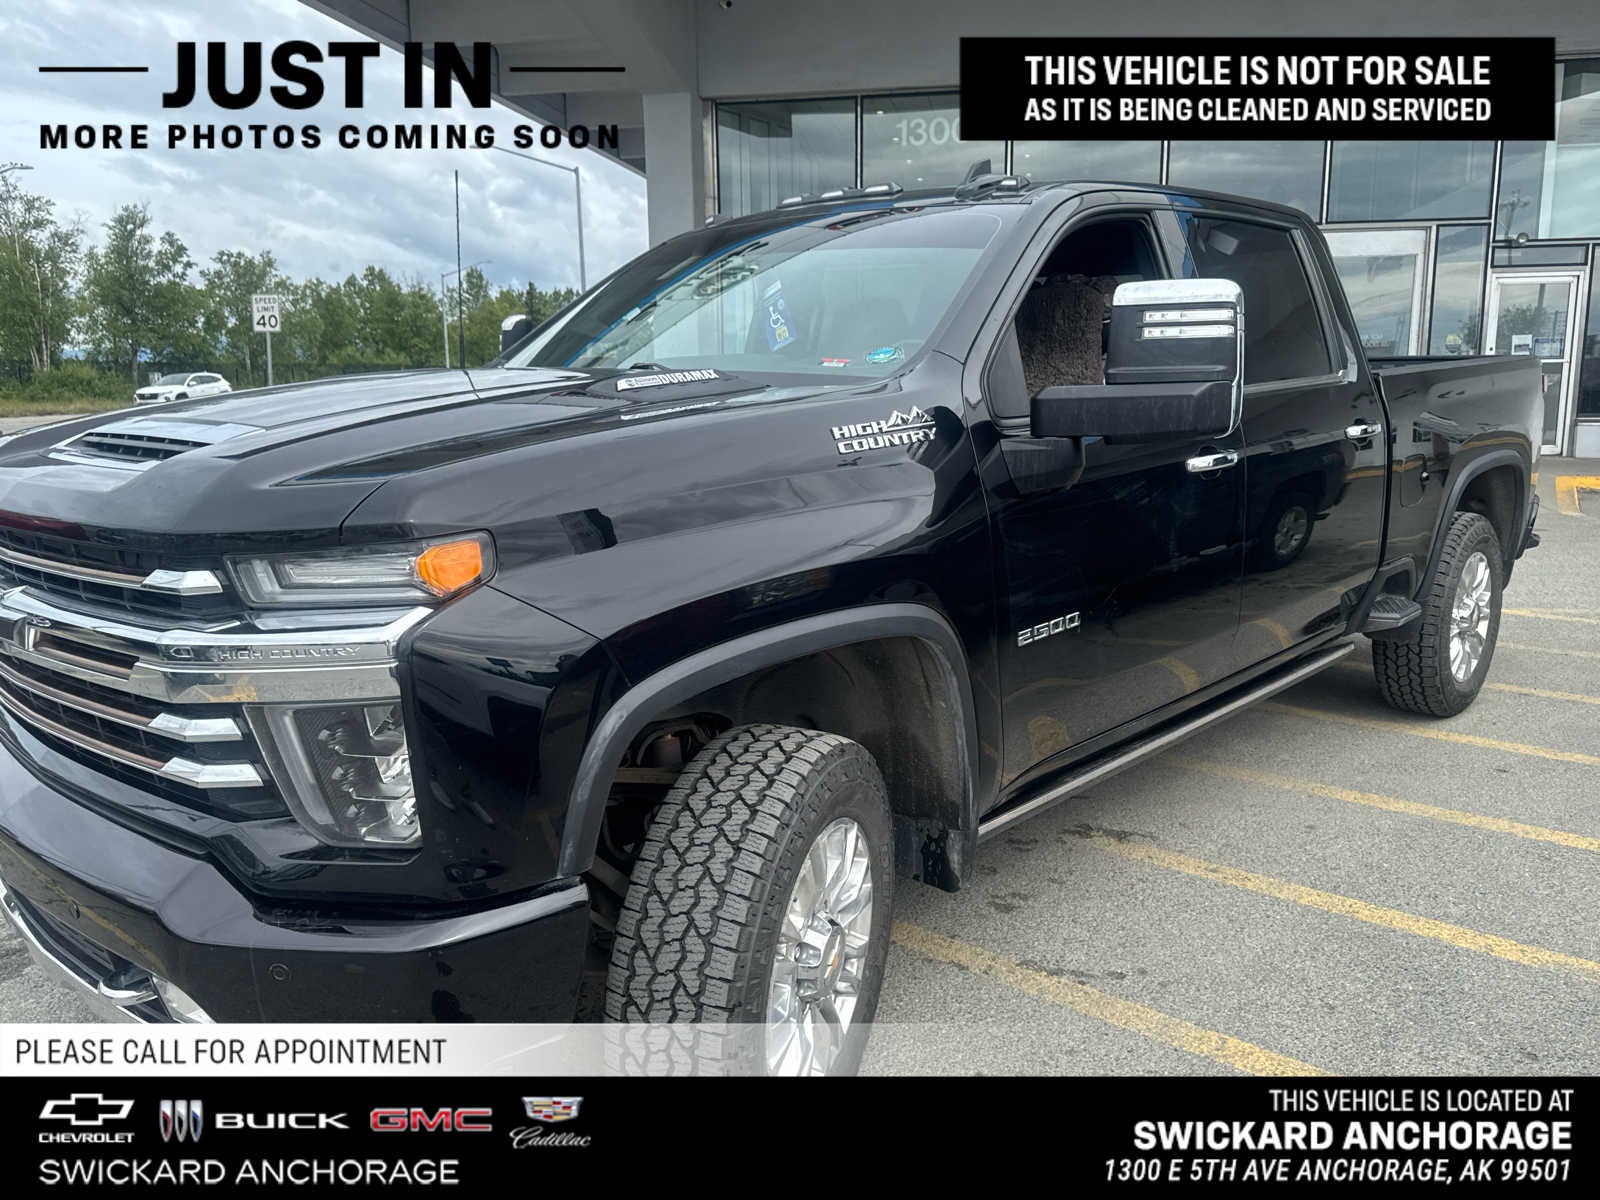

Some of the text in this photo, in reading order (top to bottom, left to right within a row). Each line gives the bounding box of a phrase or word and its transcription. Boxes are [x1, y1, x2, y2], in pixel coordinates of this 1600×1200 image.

[256, 305, 275, 313] LIMIT
[256, 314, 278, 328] 40
[659, 368, 720, 385] DURAMAX
[830, 420, 888, 440] HIGH
[836, 427, 937, 455] COUNTRY
[1017, 611, 1080, 646] 2500
[219, 646, 361, 661] HIGH COUNTRY
